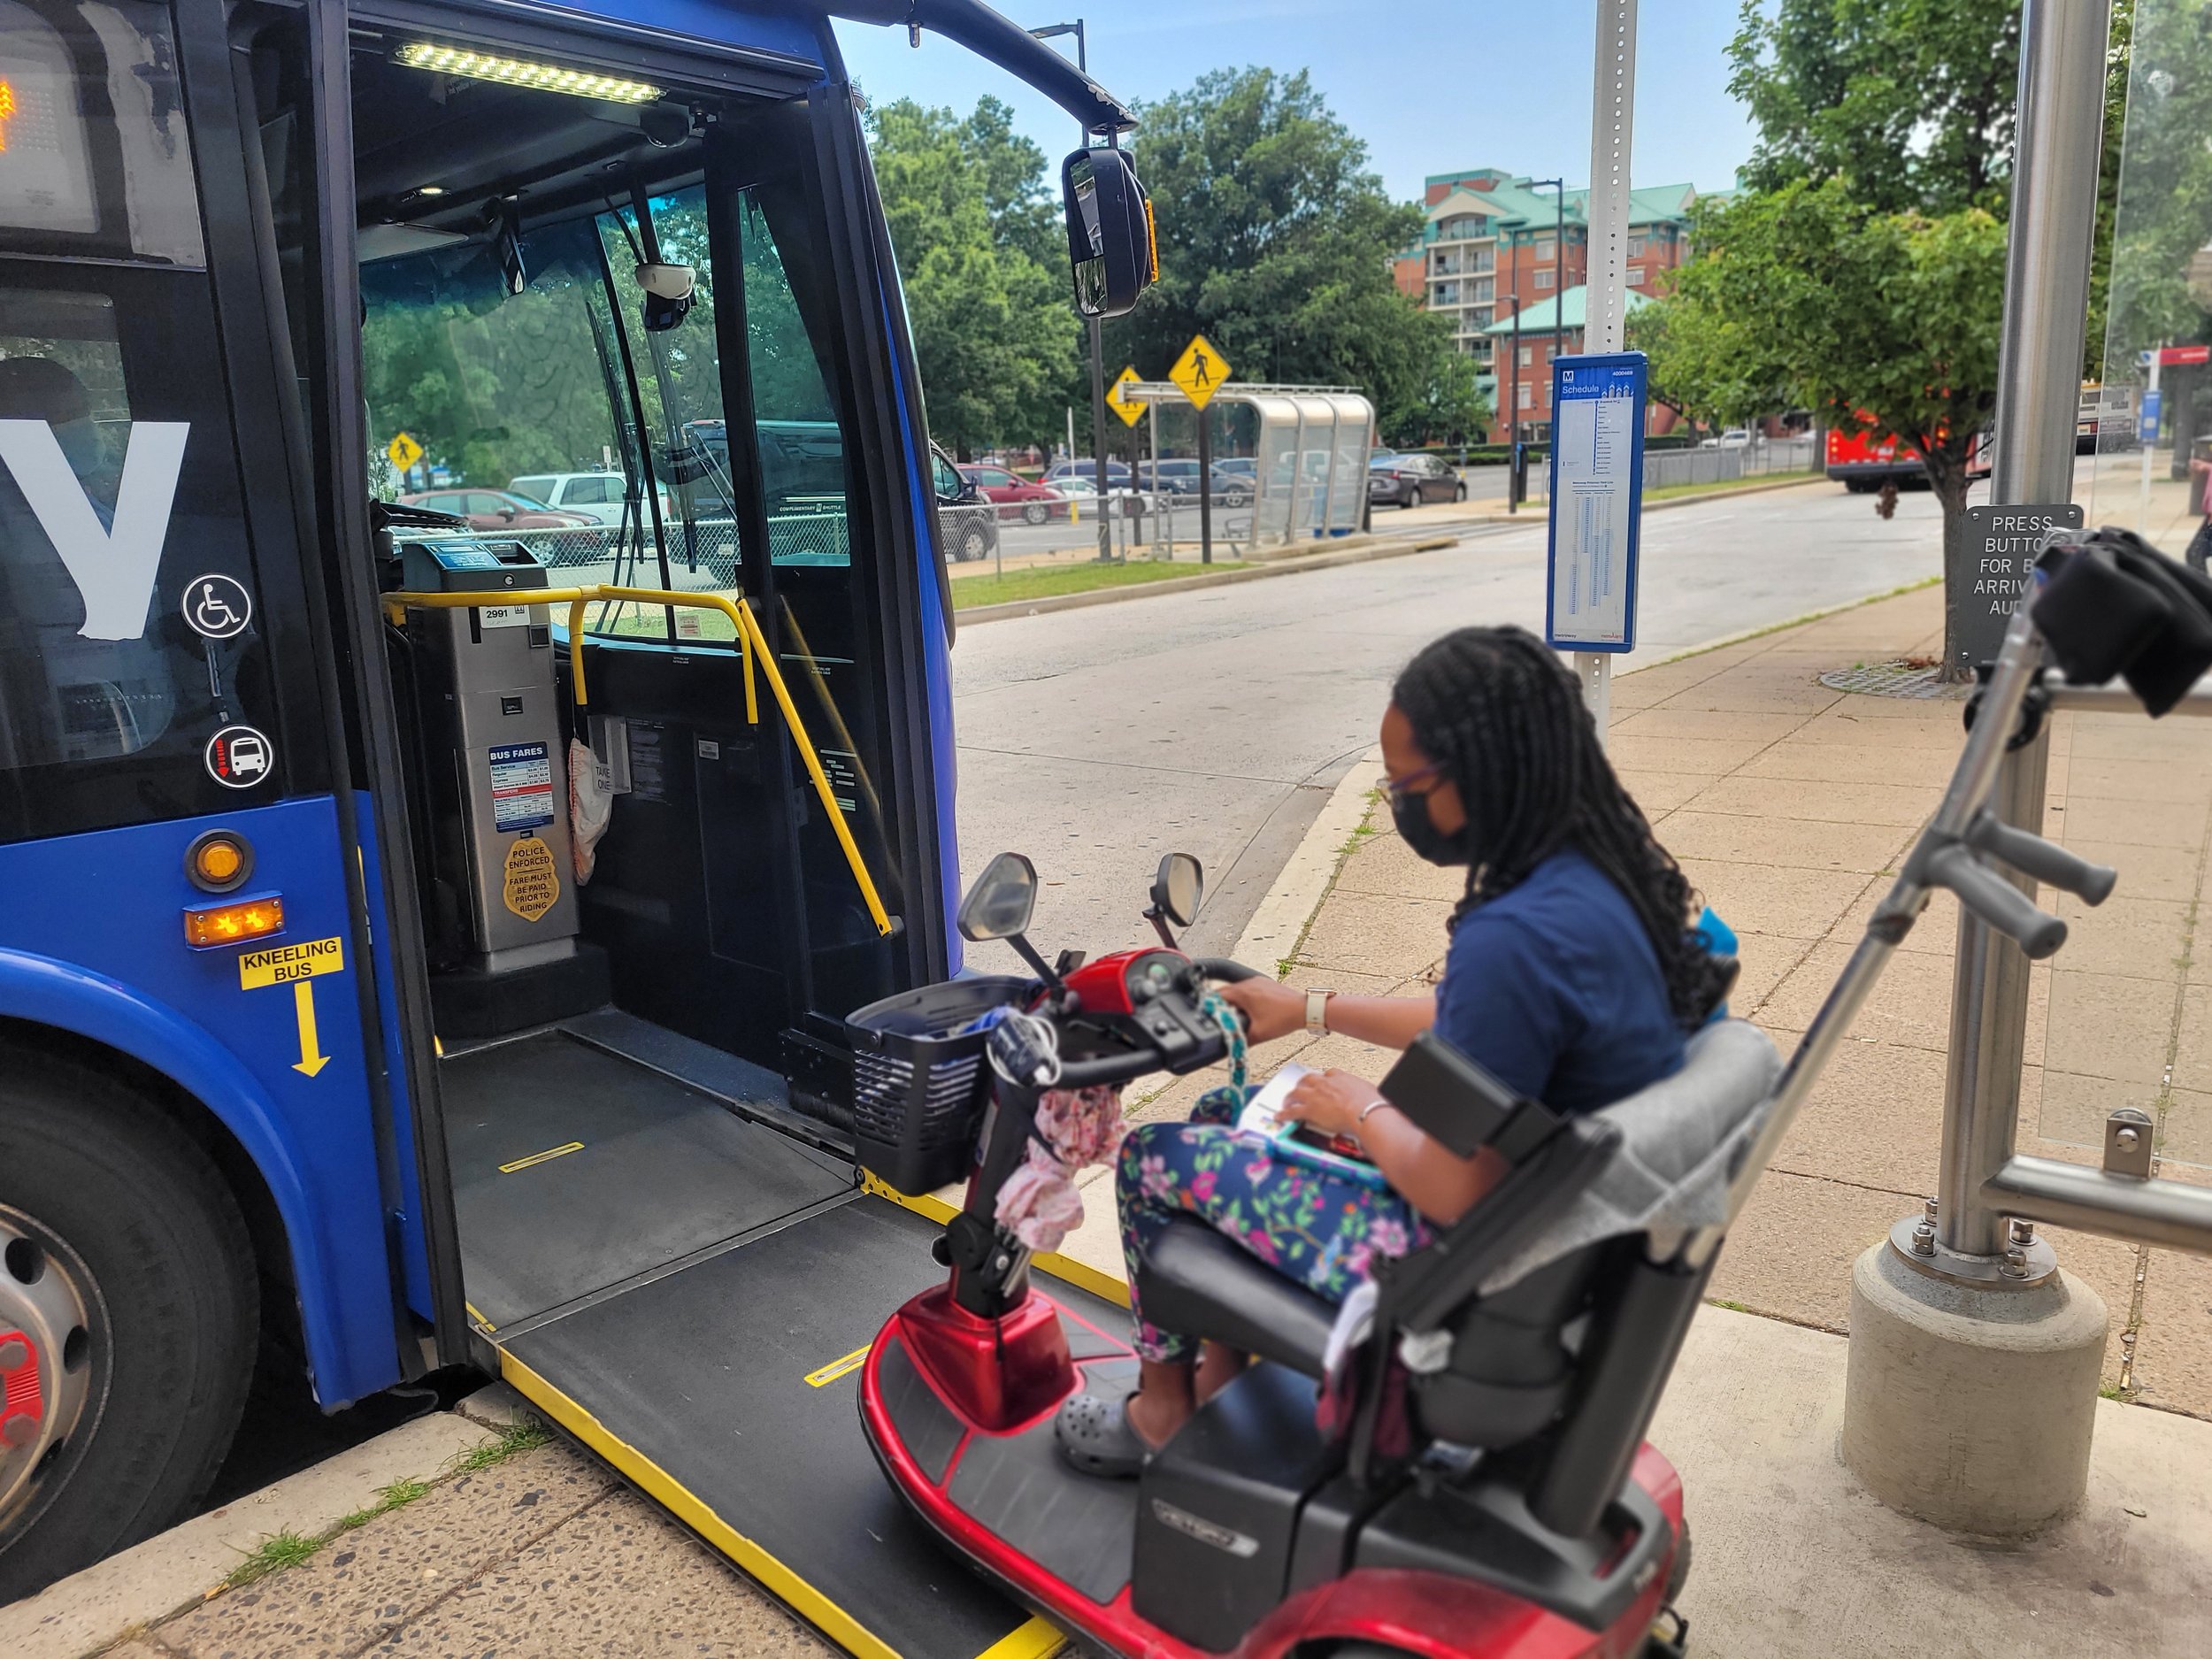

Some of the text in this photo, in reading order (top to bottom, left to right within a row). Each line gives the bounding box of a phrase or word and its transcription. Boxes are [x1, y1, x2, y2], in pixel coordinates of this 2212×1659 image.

[1563, 385, 1599, 395] Schedule
[1992, 516, 2053, 532] PRESS
[1985, 537, 2043, 553] BUTTO
[1979, 558, 2012, 574] FOR
[1973, 579, 2026, 595] ARRIV
[486, 609, 508, 618] 2991
[490, 747, 543, 761] BUS FARES
[595, 766, 611, 778] TAKE
[597, 779, 611, 790] ONE
[512, 846, 545, 858] POLICE
[509, 856, 550, 869] ENFORCED
[510, 872, 552, 886] FARE MUST
[528, 883, 547, 892] PAID
[515, 895, 539, 903] PRIOR
[519, 902, 548, 912] RIDING
[243, 940, 338, 970] KNEELING
[274, 962, 312, 982] BUS
